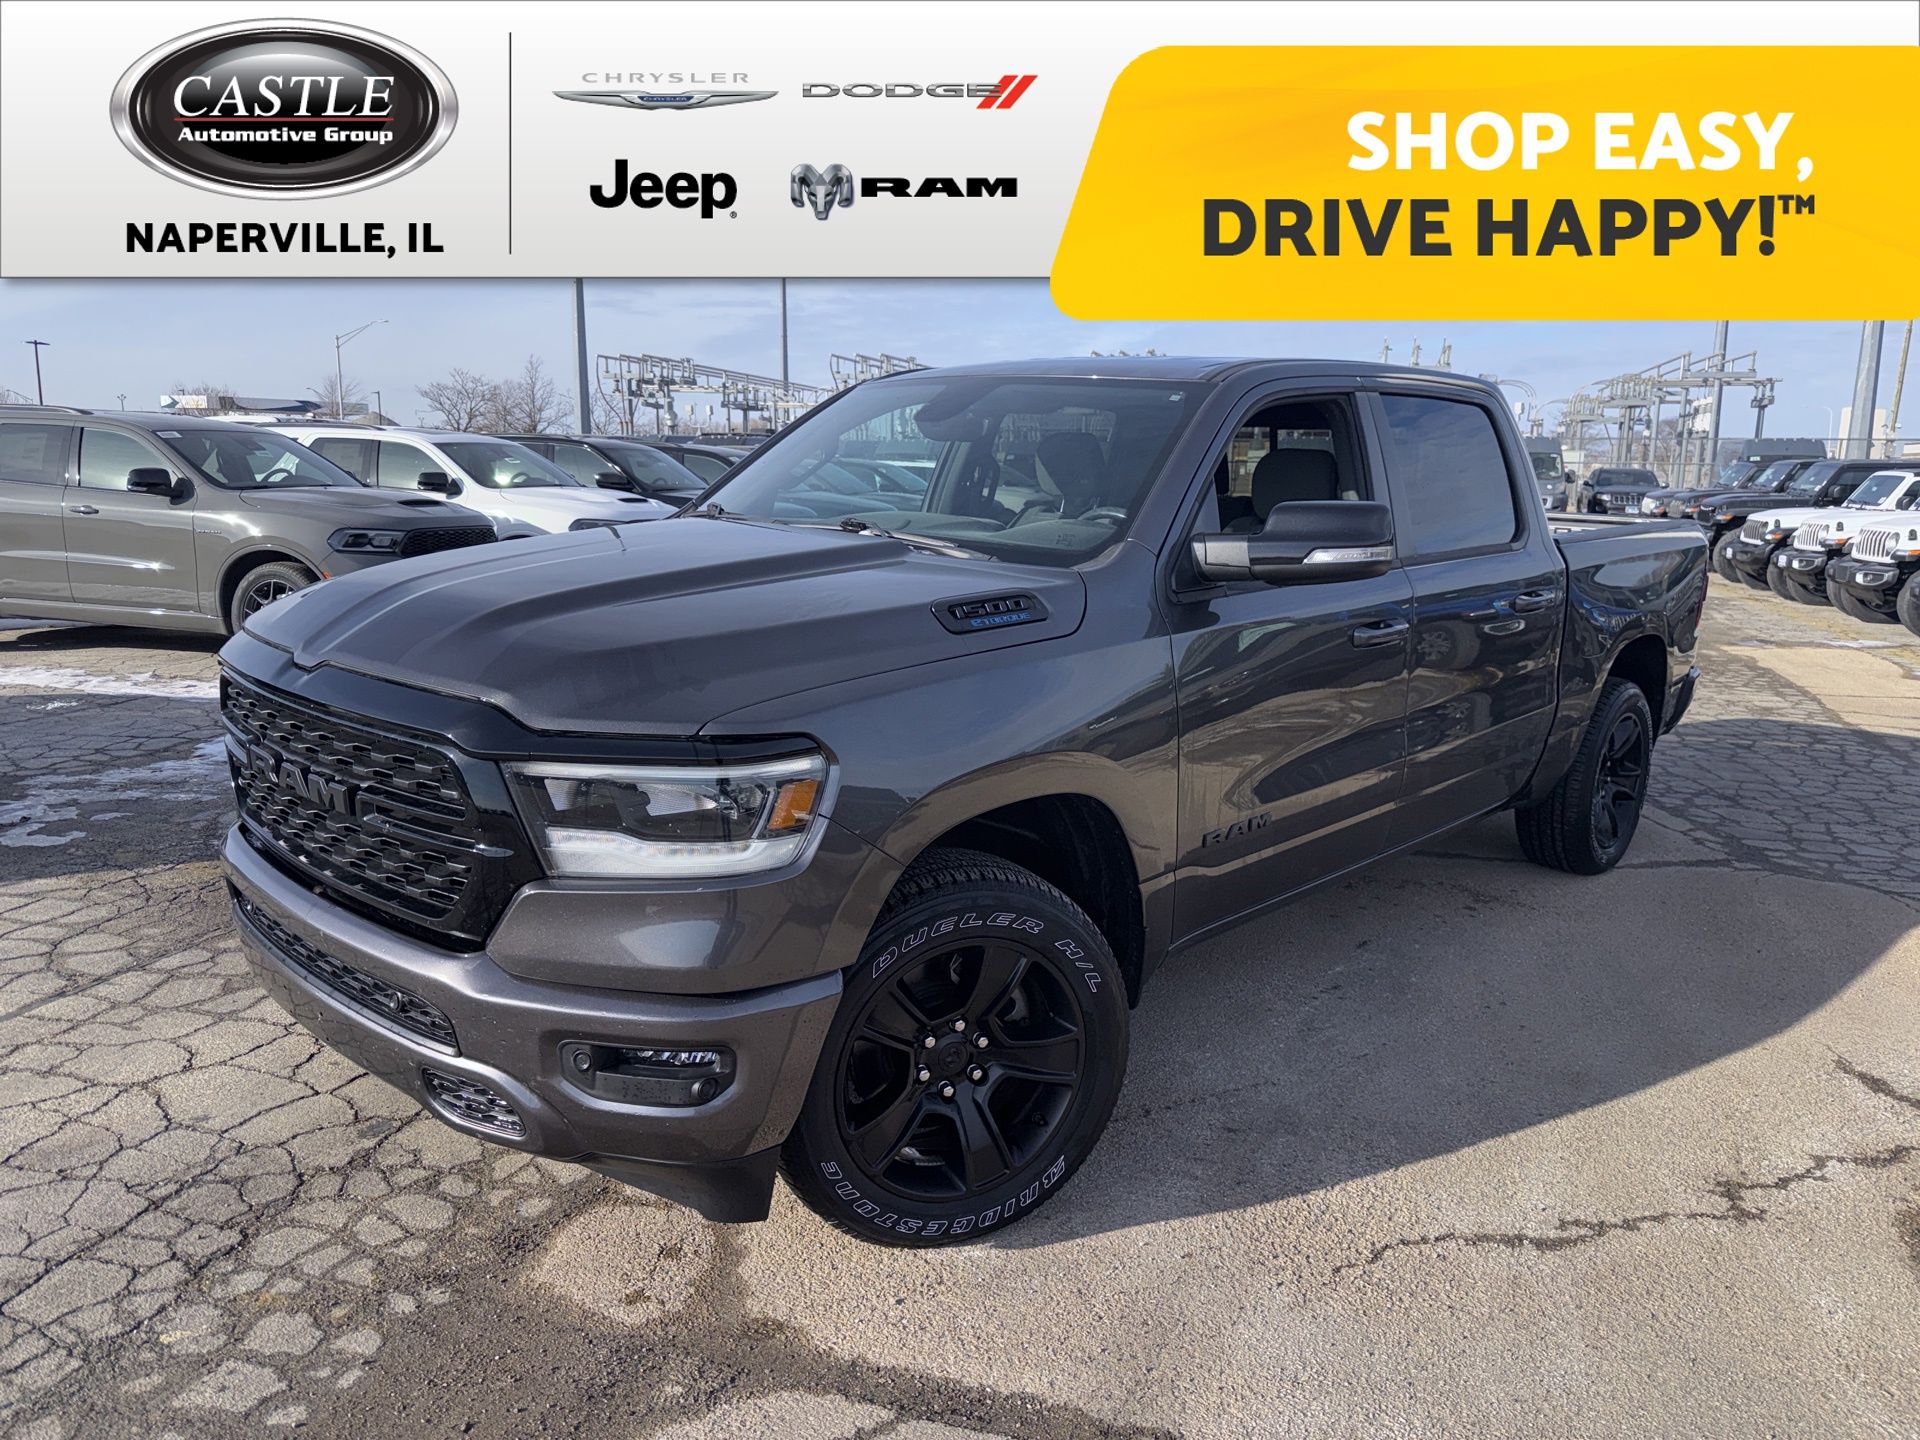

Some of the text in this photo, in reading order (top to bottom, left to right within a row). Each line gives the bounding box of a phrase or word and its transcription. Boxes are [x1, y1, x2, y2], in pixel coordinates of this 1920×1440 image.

[951, 599, 1026, 620] 1500
[249, 743, 351, 816] RAM
[1201, 811, 1273, 849] RAM
[872, 911, 1045, 979] DUELER
[820, 1154, 1066, 1237] BRIDGESTONE
